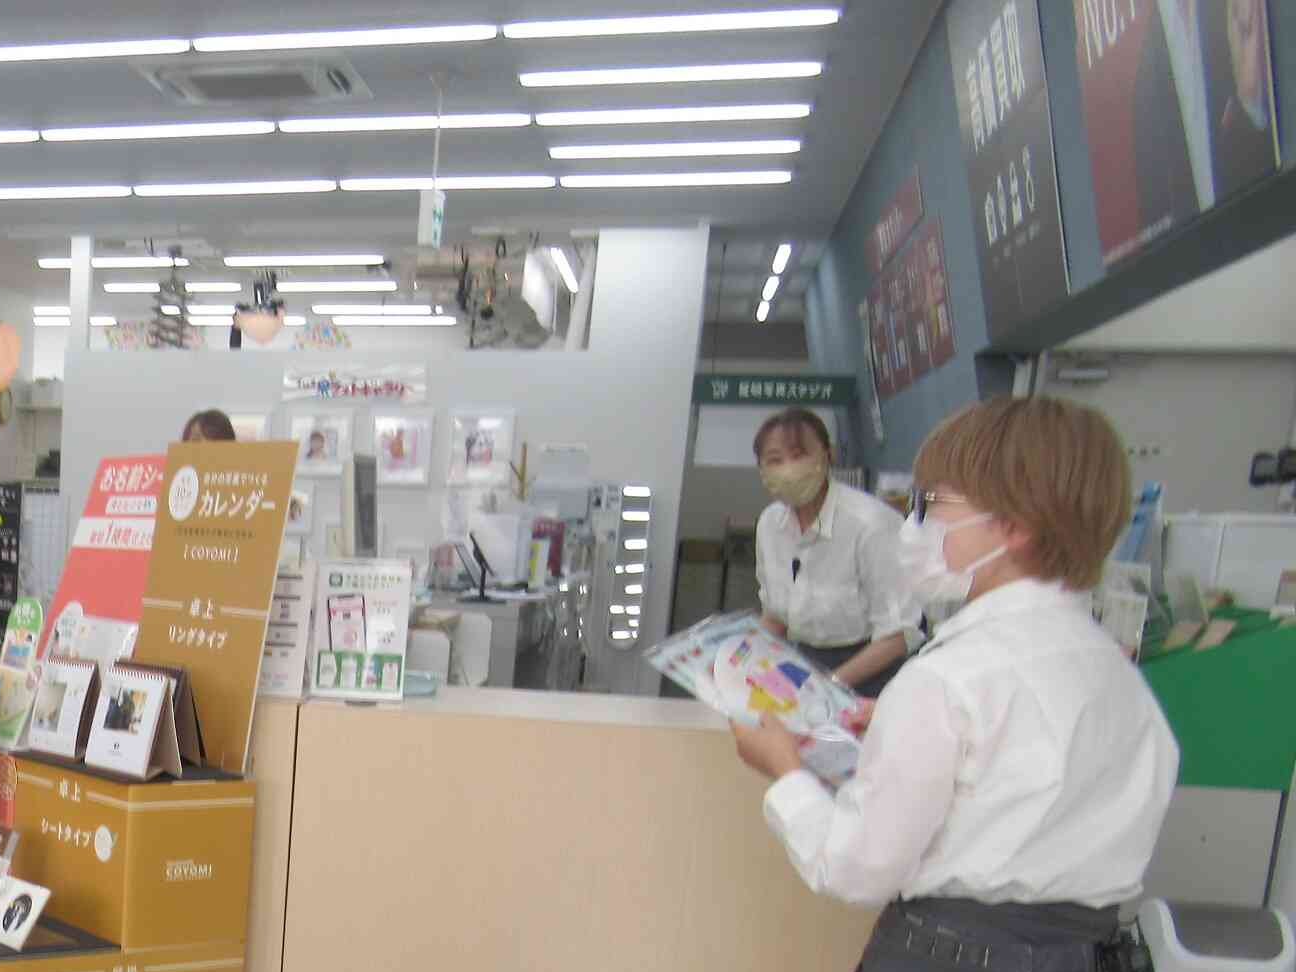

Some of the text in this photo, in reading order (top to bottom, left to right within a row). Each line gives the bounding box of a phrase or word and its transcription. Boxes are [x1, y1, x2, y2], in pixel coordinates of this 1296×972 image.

[199, 489, 276, 520] カレンダー
[168, 624, 227, 649] リングタイプ
